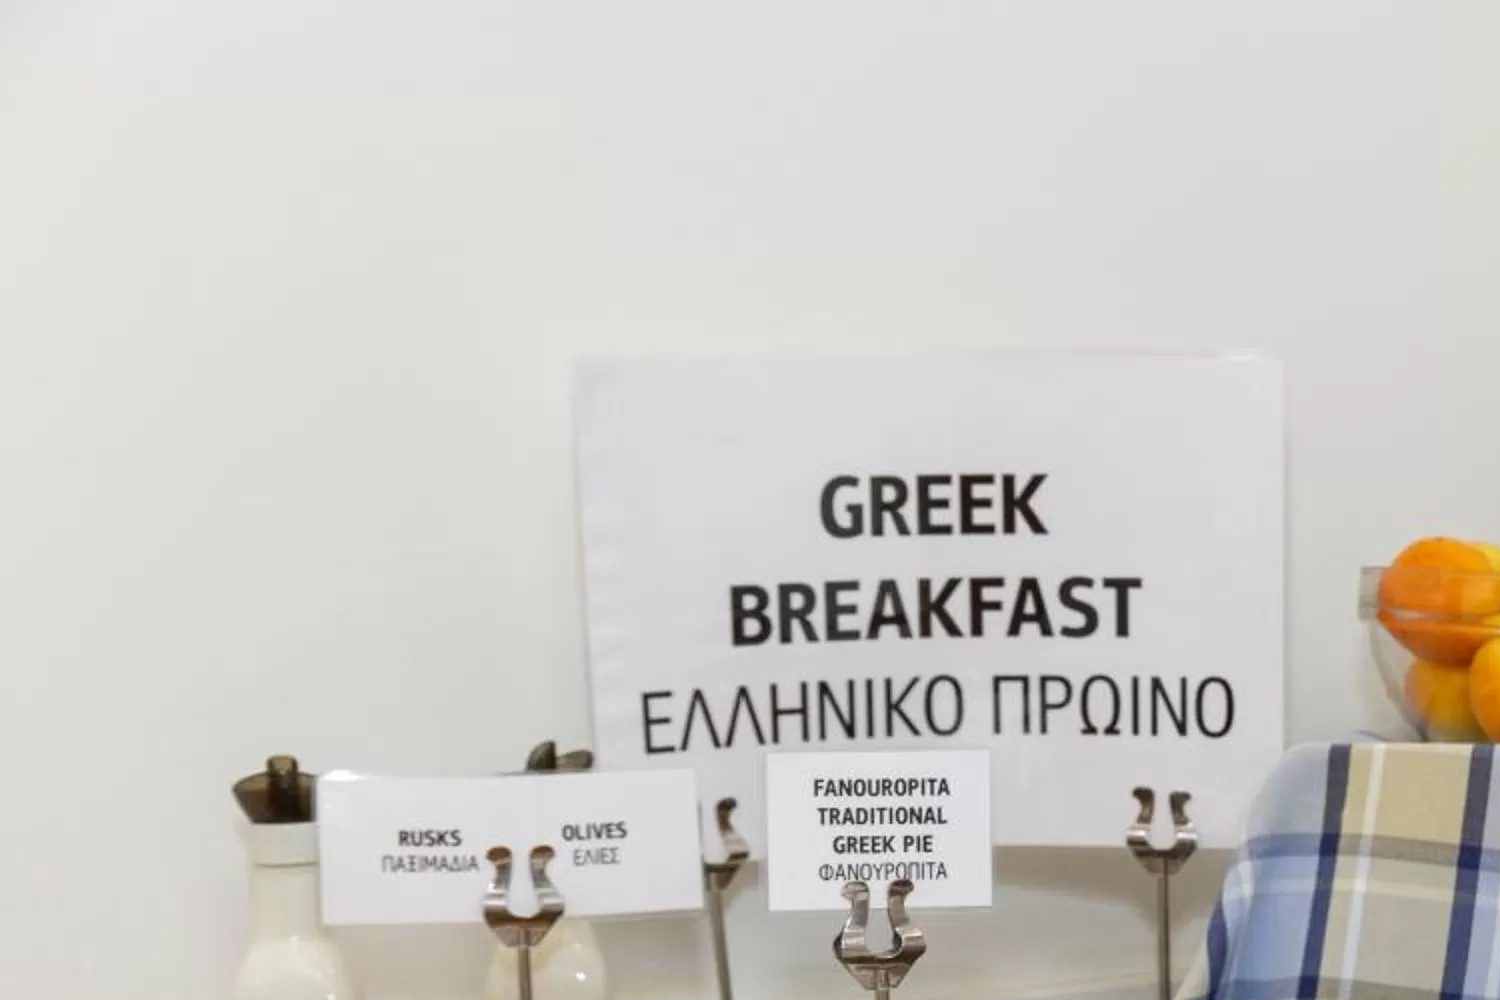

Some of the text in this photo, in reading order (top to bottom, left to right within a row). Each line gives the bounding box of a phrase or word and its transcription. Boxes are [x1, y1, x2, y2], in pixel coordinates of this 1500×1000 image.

[820, 473, 1049, 539] GREEK
[730, 576, 1143, 647] BREAKFAST
[641, 674, 1235, 755] ΕΛΛΗΝΙΚΟ ΠΡΩΙΝΟ
[813, 777, 951, 798] FANOUROPITA
[817, 806, 948, 826] TRADITIONAL
[398, 829, 462, 847] RUSKS
[561, 821, 628, 842] OLIVES
[832, 834, 933, 855] GREEK PIE
[382, 854, 479, 873] ΠΑΞΙΜΑΔΙΑ
[572, 846, 620, 867] ΕΛΙΕΣ
[817, 860, 949, 881] ΦΑΝΟΥΡΟΠΙΤΑ
